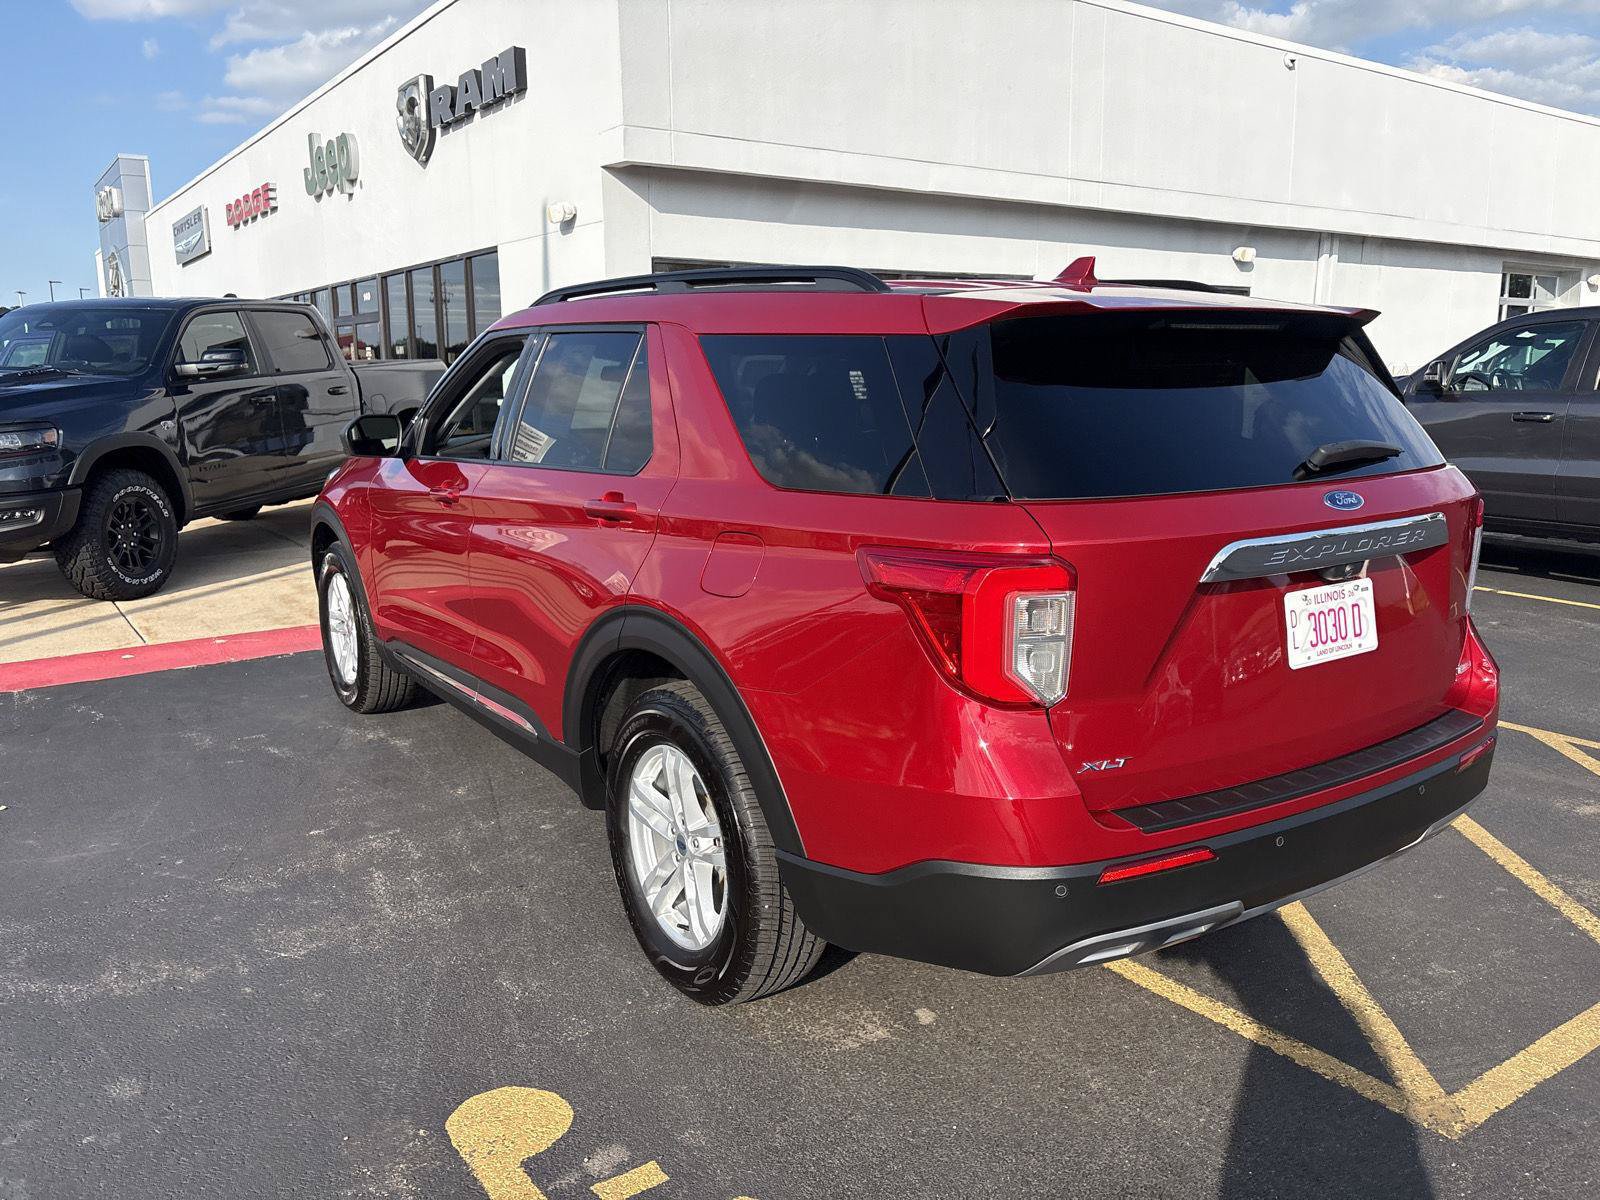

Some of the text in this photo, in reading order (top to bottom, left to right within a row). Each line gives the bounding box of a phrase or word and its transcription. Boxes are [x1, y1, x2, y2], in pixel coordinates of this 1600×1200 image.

[430, 46, 524, 128] RAM
[304, 132, 356, 196] Jeep
[225, 182, 273, 226] DODGE
[173, 211, 202, 237] CHRYSLER
[1264, 530, 1426, 565] EXPLORER
[1313, 589, 1346, 605] ILLINOIS
[1308, 603, 1363, 648] 3030 D
[1316, 648, 1328, 657] LAND
[1335, 643, 1353, 653] LINCOLN
[1077, 756, 1133, 774] XLT
